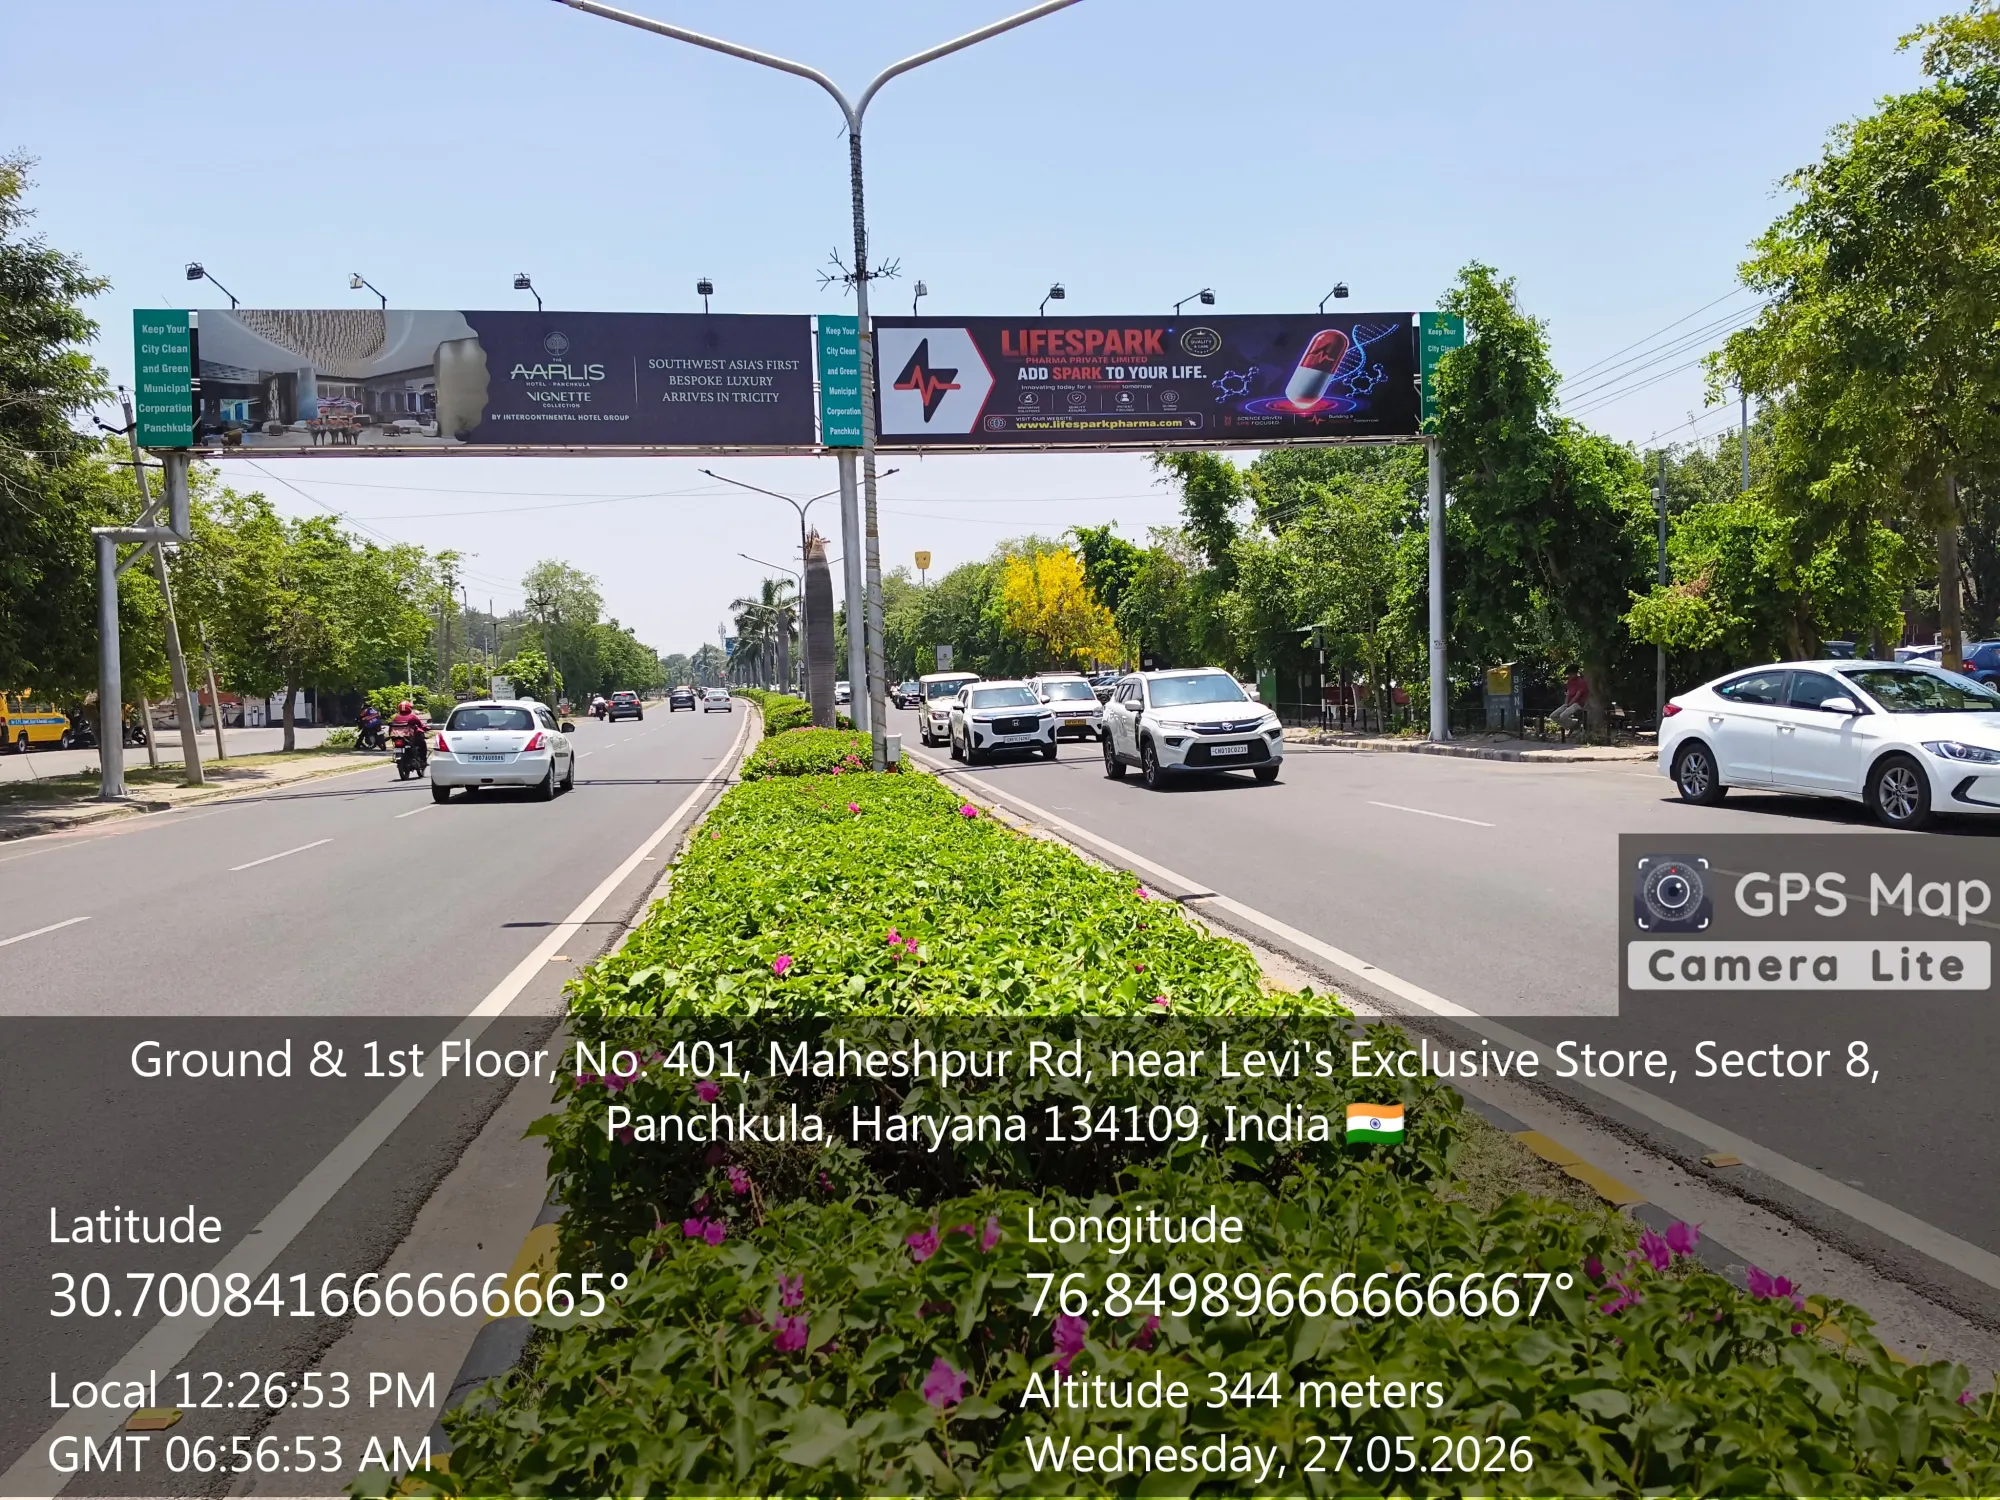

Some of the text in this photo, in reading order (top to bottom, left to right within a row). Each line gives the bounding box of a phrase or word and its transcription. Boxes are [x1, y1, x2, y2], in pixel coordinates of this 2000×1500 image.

[142, 325, 186, 335] Keep Your
[826, 326, 856, 336] Keep Your
[1428, 328, 1442, 336] Keep
[1002, 328, 1164, 356] LIFESPARK
[142, 344, 188, 355] City Clean
[826, 346, 856, 356] City Clean
[1428, 345, 1440, 353] City
[142, 364, 188, 373] and Green
[648, 358, 800, 370] SOUTHWEST ASIA'S FIRST
[510, 364, 606, 380] AARLIS
[827, 367, 858, 375] and Green
[1018, 366, 1208, 380] ADD SPARK TO YOUR LIFE.
[669, 376, 774, 386] BESPOKE LUXURY
[144, 384, 190, 394] Municipal
[829, 386, 858, 396] Municipal
[526, 392, 592, 402] VIGNETTE
[662, 392, 780, 403] ARRIVES IN TRICITY
[138, 404, 192, 414] Corporation
[826, 407, 862, 416] Corporation
[144, 424, 192, 432] Panchkula
[1016, 420, 1182, 429] www.lifesparkpharma.com
[830, 427, 860, 436] Panchkula
